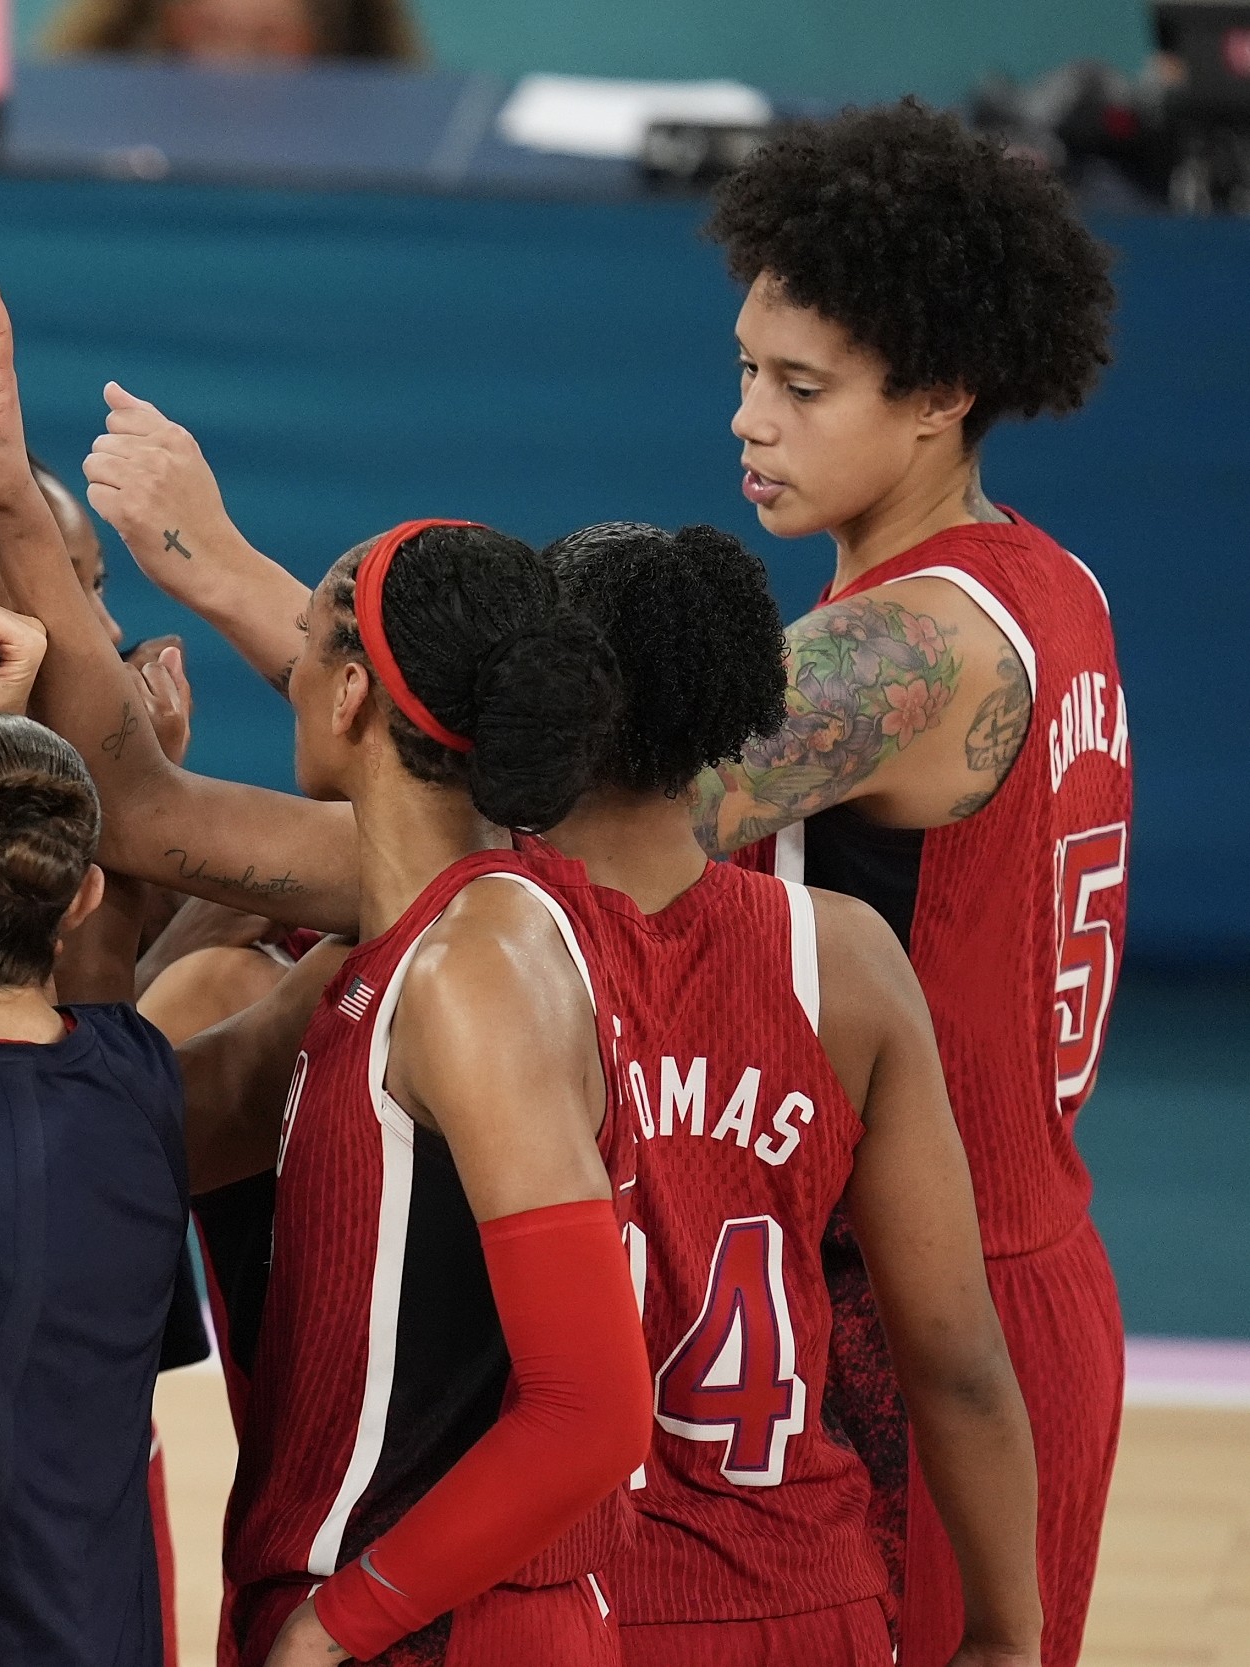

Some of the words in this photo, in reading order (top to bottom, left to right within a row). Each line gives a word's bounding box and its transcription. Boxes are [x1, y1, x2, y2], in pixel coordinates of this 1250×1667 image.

[1053, 820, 1127, 1117] 5
[629, 1056, 815, 1167] OMAS
[625, 1214, 806, 1490] 4
